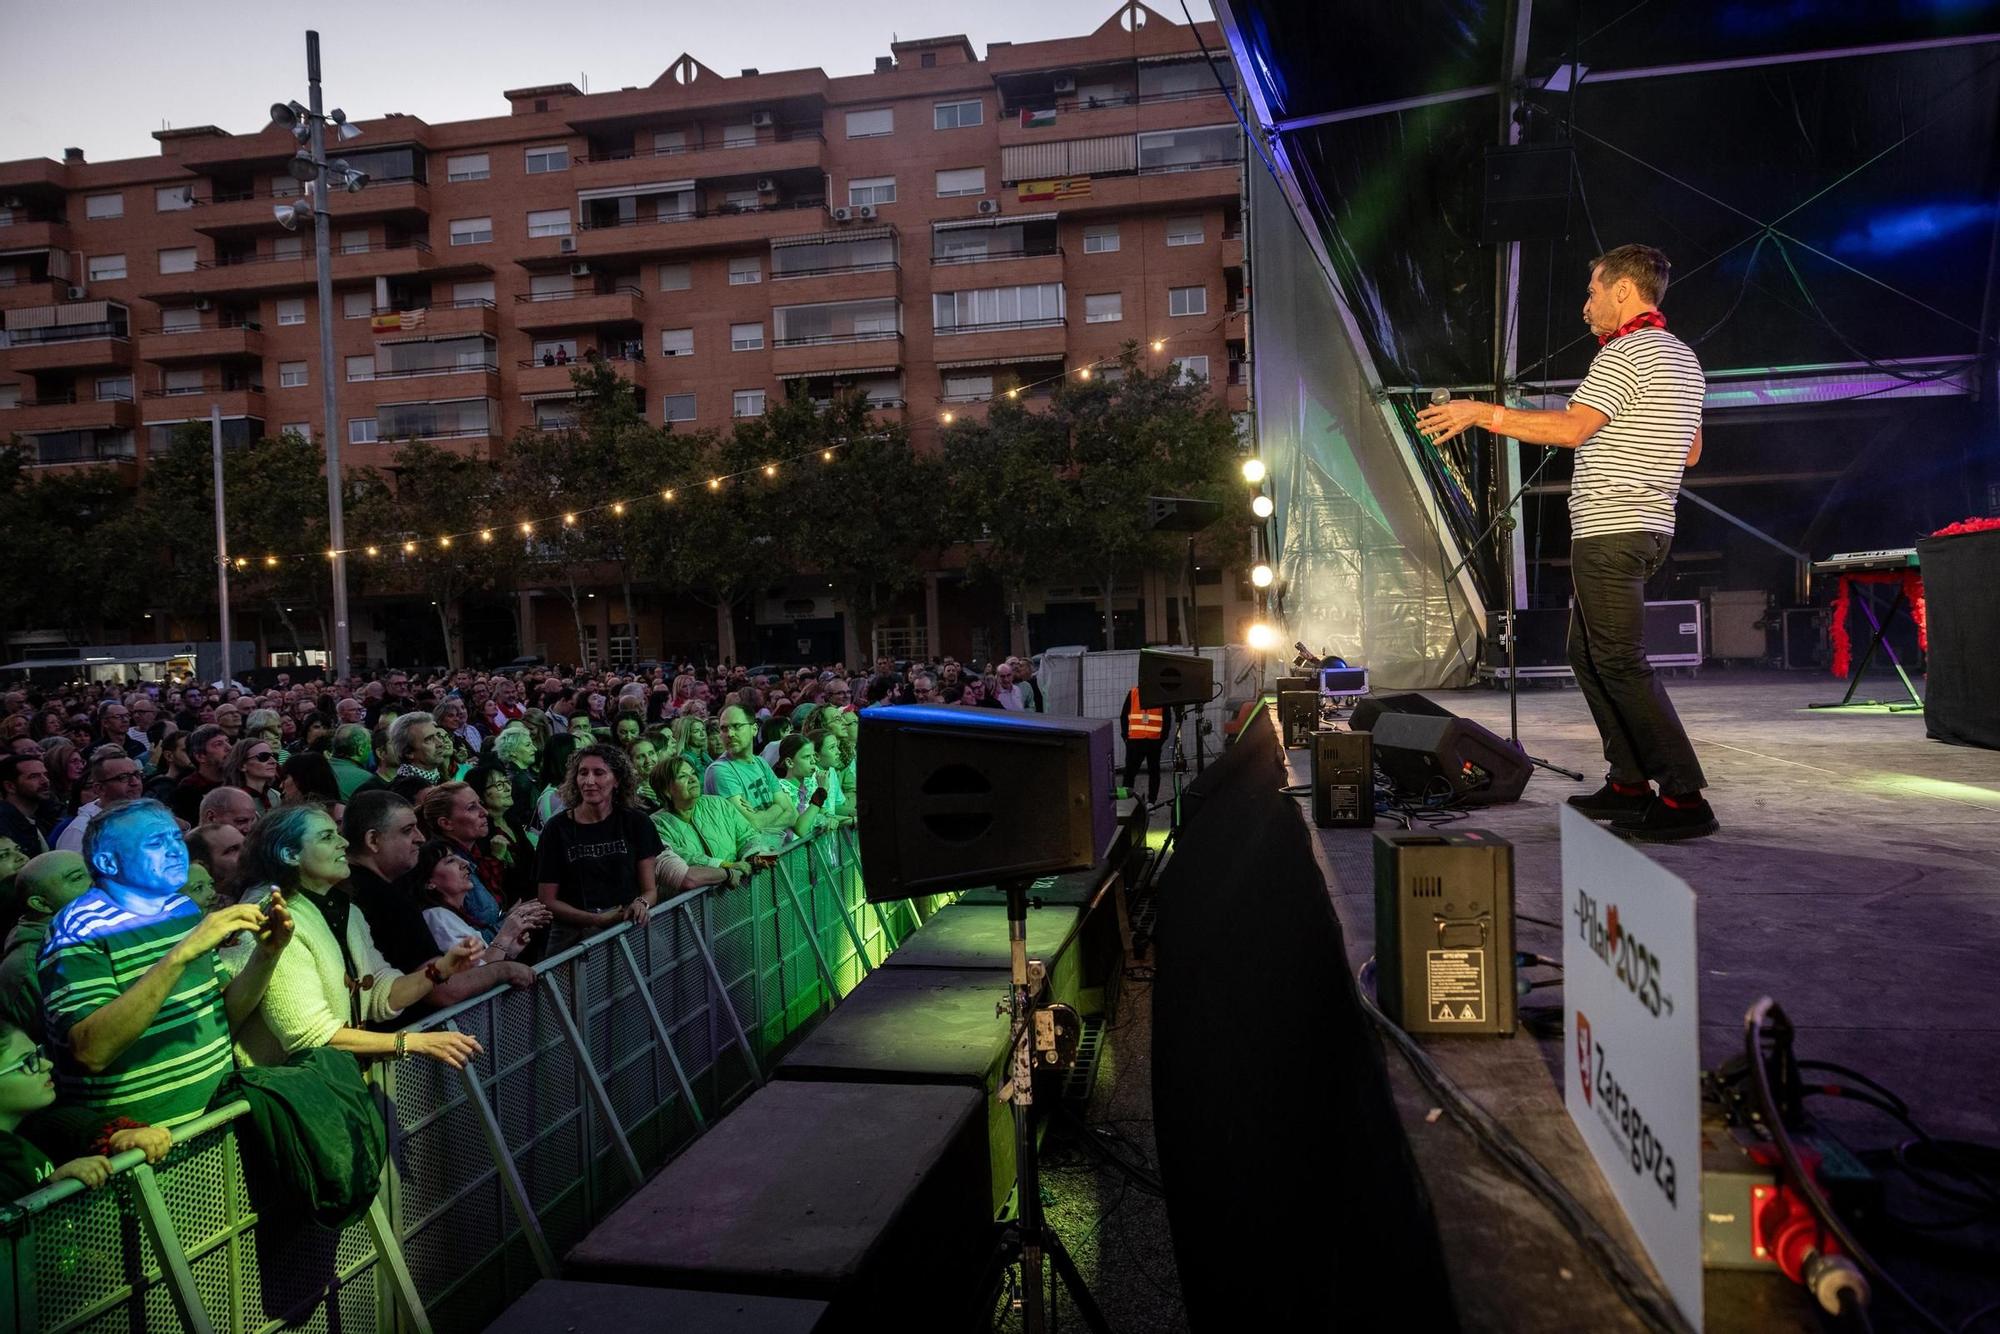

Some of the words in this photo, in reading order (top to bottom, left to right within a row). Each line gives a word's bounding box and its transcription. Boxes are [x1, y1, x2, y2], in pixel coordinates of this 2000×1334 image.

[1579, 888, 1610, 967] Pilar
[1616, 923, 1661, 1018] 2025
[1596, 1041, 1677, 1210] Zaragoza
